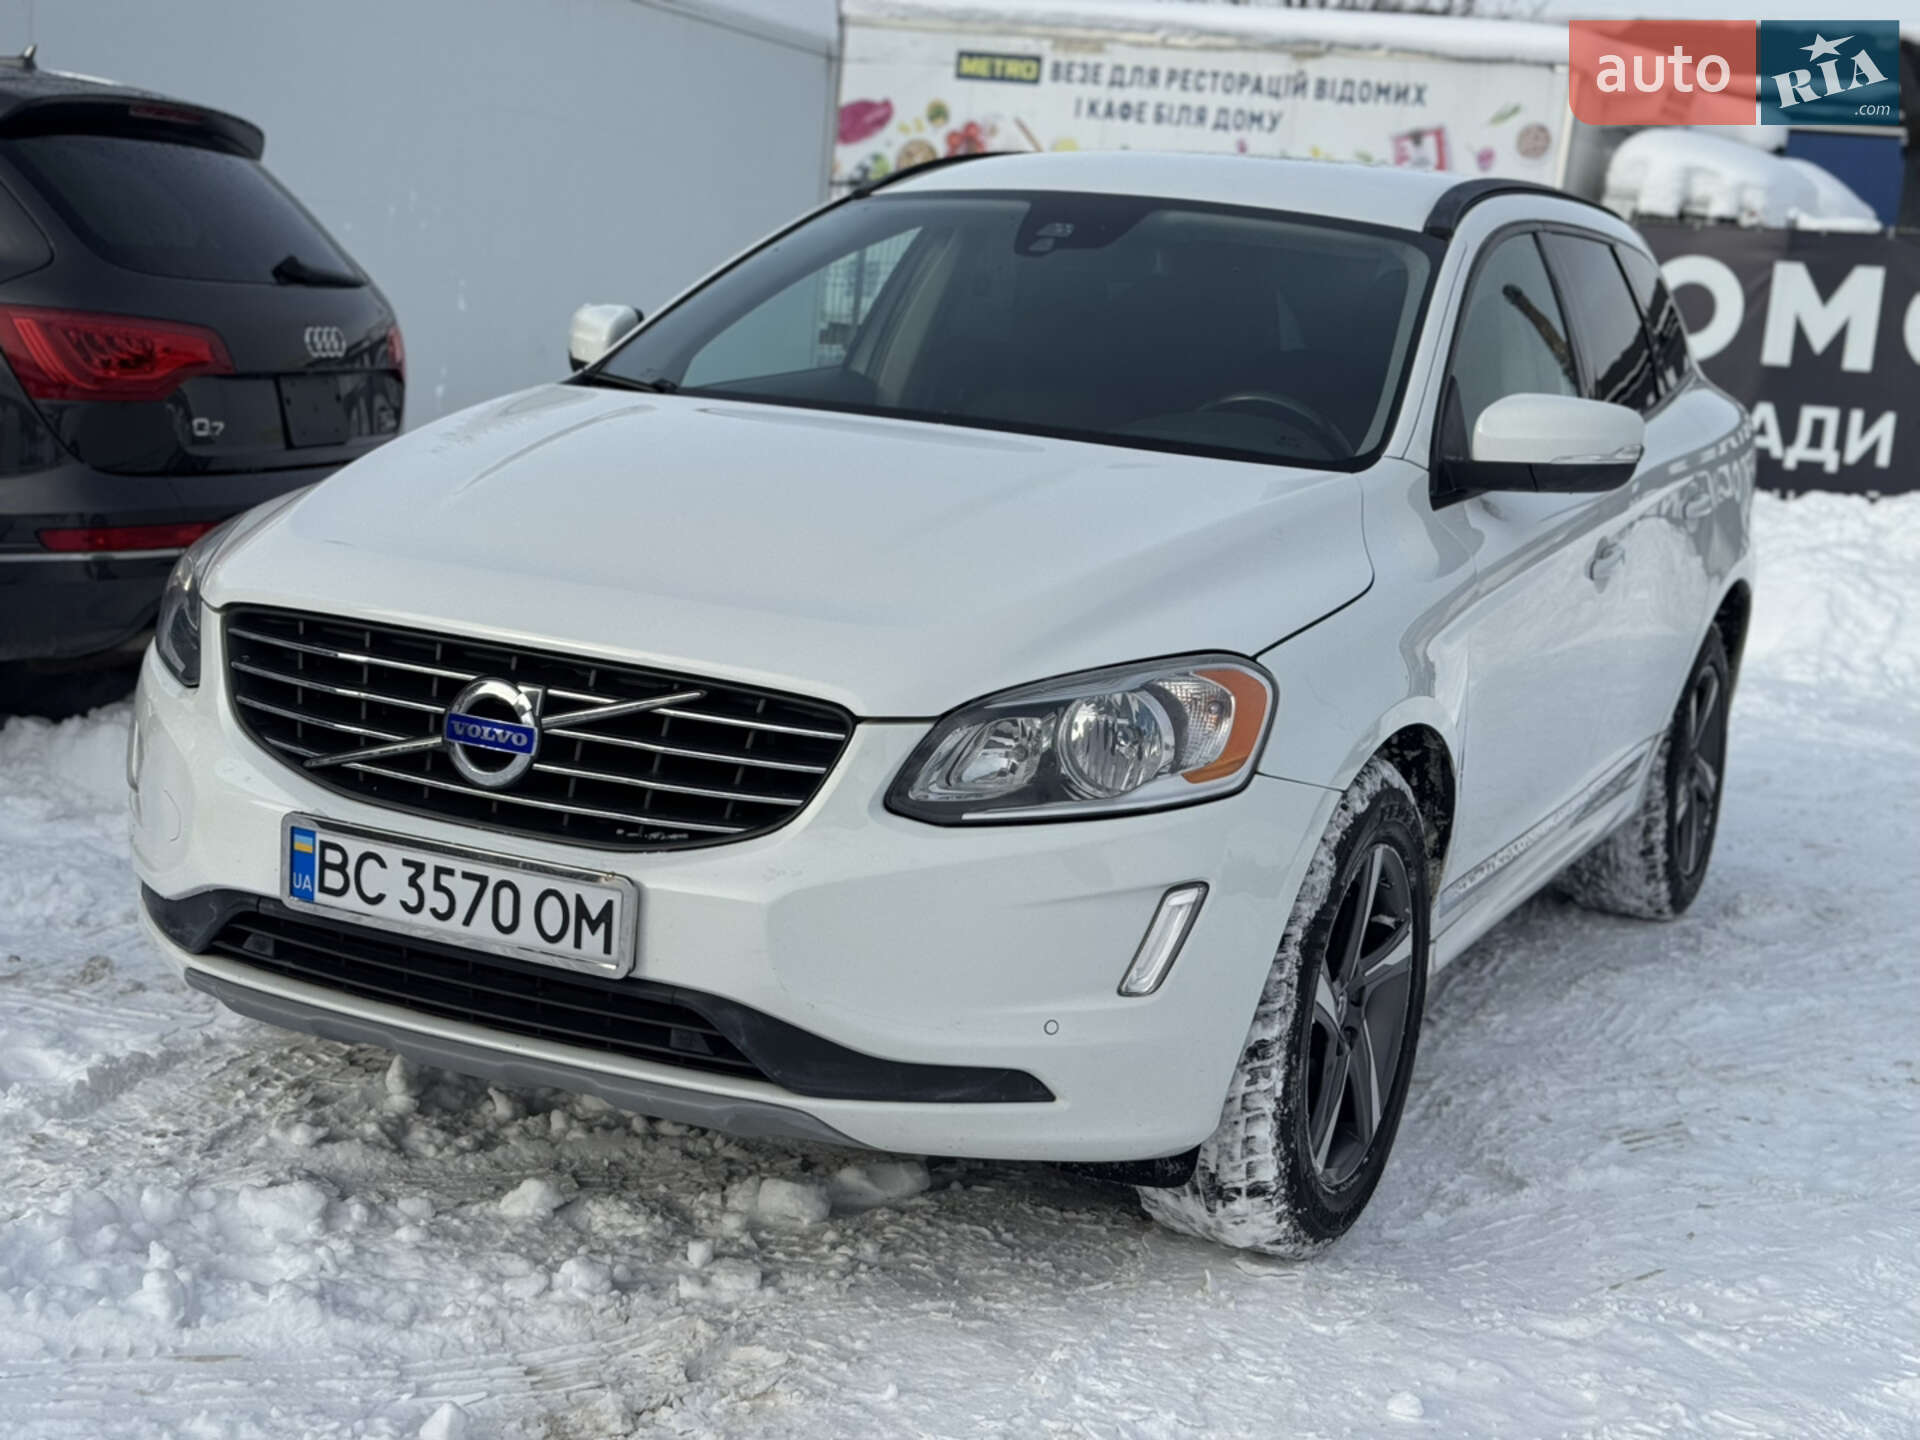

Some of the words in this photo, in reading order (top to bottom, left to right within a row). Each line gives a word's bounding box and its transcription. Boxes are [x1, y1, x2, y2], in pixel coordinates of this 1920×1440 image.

[958, 55, 1038, 80] METRO
[1051, 59, 1101, 86] ВЕЗЕ
[1108, 64, 1161, 89] ДЛЯ
[1165, 65, 1309, 99] РЕСТОРАЦІЙ
[1314, 77, 1427, 106] ВІДОМИХ
[1086, 98, 1148, 124] КАФЕ
[1154, 102, 1207, 127] БІЛЯ
[1212, 107, 1284, 133] ДОМУ
[1660, 254, 1920, 373] ОМ
[192, 418, 225, 436] Q7
[451, 720, 528, 747] VOLVO
[292, 875, 312, 893] UA
[318, 839, 388, 906] BC
[399, 857, 521, 935] 3570
[533, 888, 615, 956] OM
